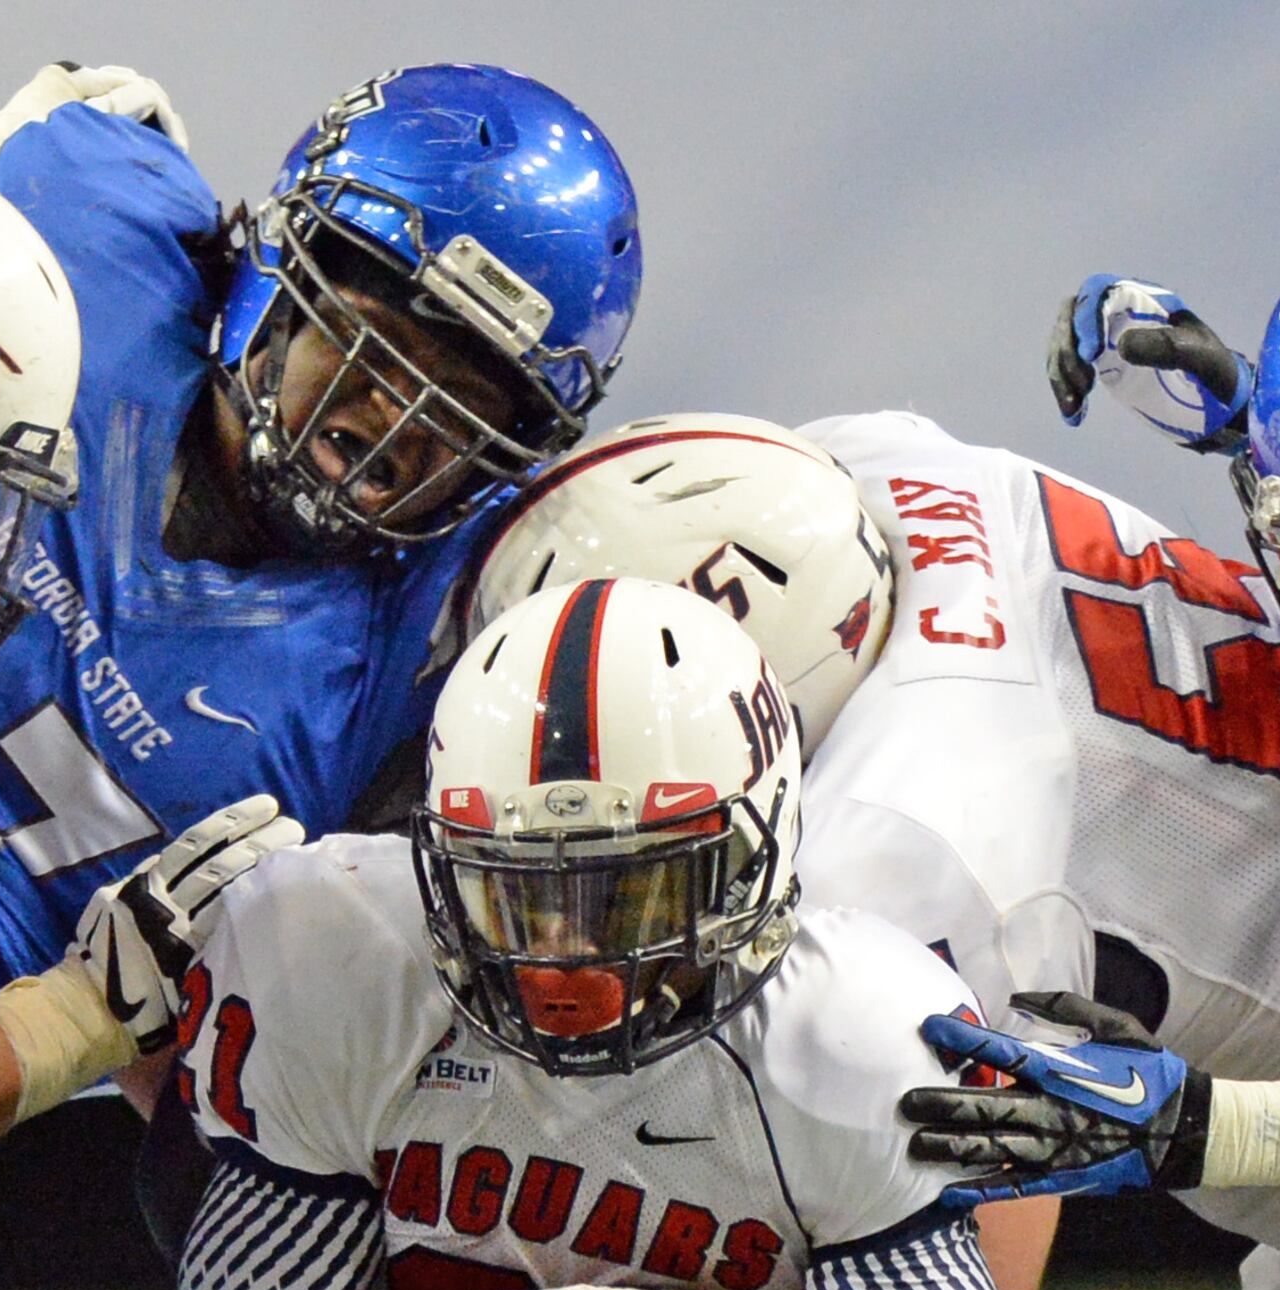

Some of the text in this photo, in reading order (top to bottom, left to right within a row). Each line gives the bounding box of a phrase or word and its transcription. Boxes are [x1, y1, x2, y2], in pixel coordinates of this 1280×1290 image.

[888, 476, 995, 579] MAY
[80, 656, 173, 763] STATE
[437, 1058, 491, 1083] BELT
